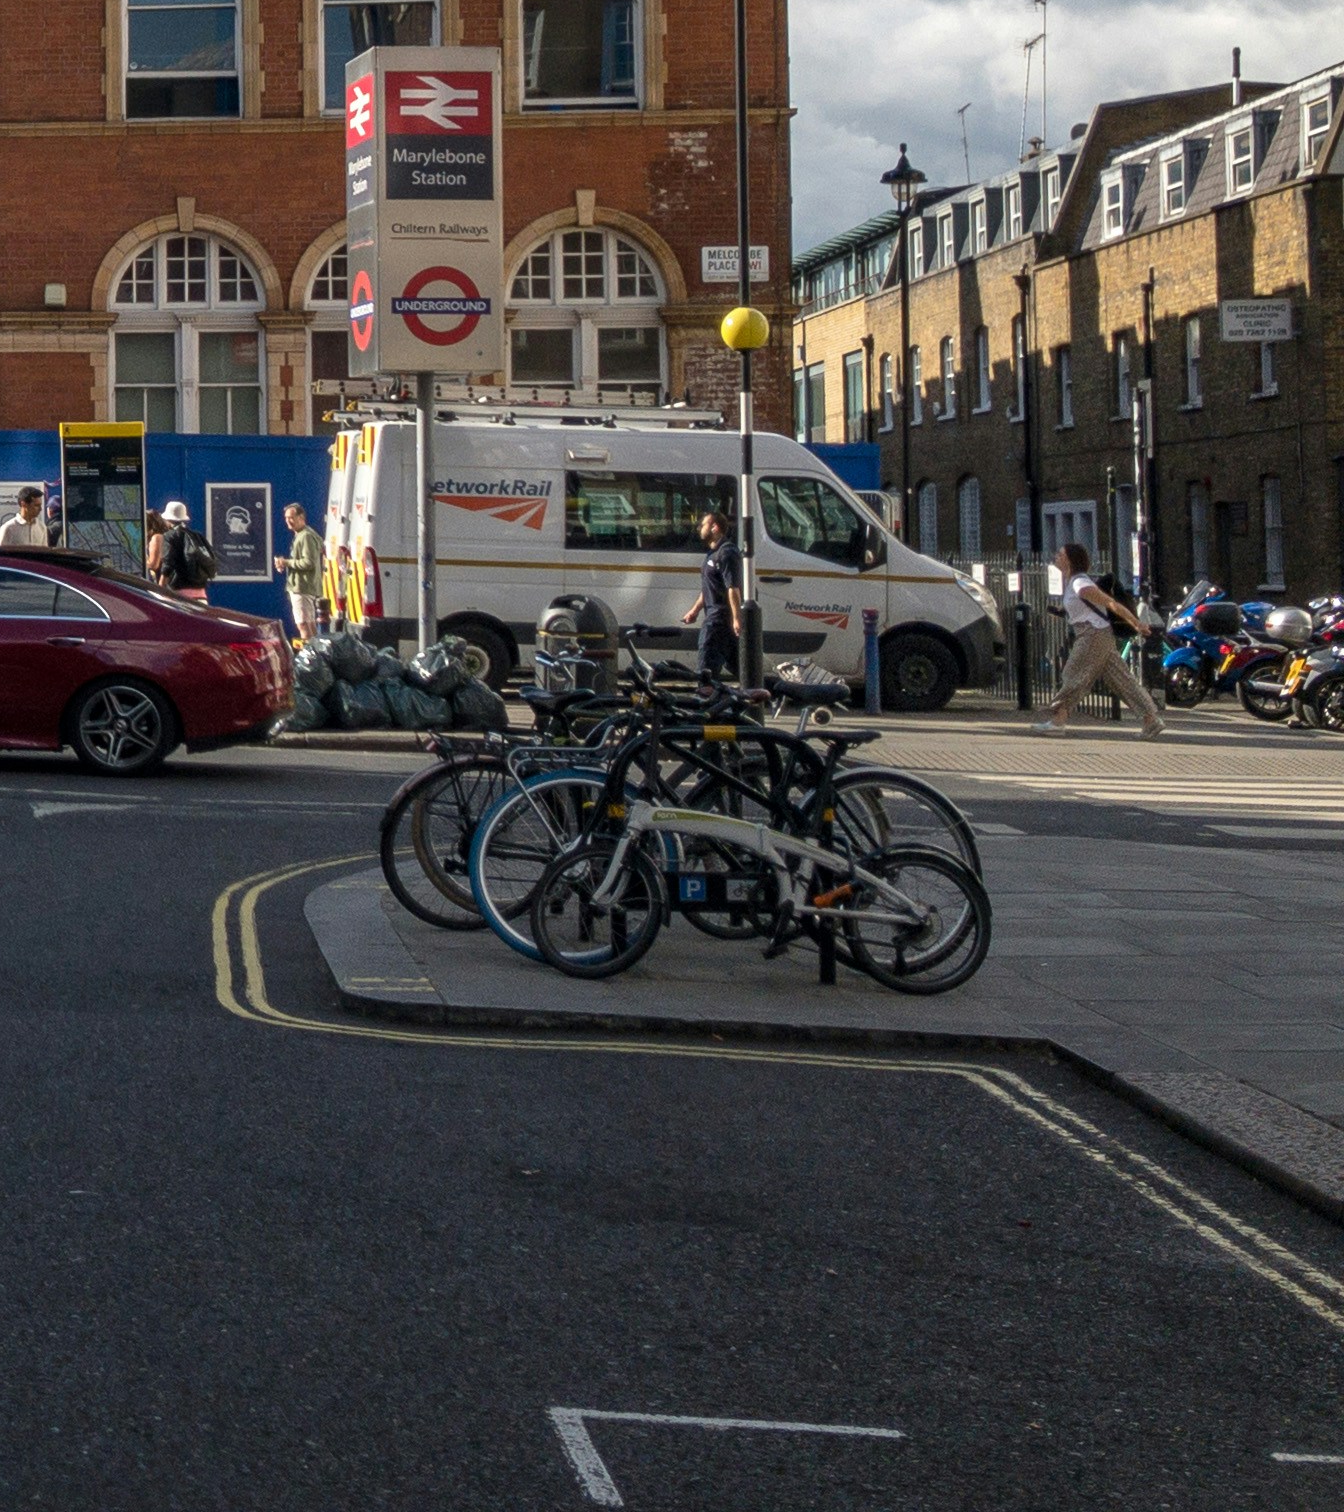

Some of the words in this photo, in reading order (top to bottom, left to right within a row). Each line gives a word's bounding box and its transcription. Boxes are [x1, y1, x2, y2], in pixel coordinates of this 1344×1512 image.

[393, 148, 487, 166] Marylebone
[411, 170, 467, 186] Station
[391, 223, 436, 234] Chiltern
[439, 224, 488, 236] Railways
[708, 250, 762, 260] MELCOBE
[708, 261, 737, 271] PLACE
[395, 300, 487, 311] UNDERGROUND
[429, 479, 552, 497] etworkRail
[784, 602, 852, 613] NetworkRail
[686, 879, 701, 897] P
